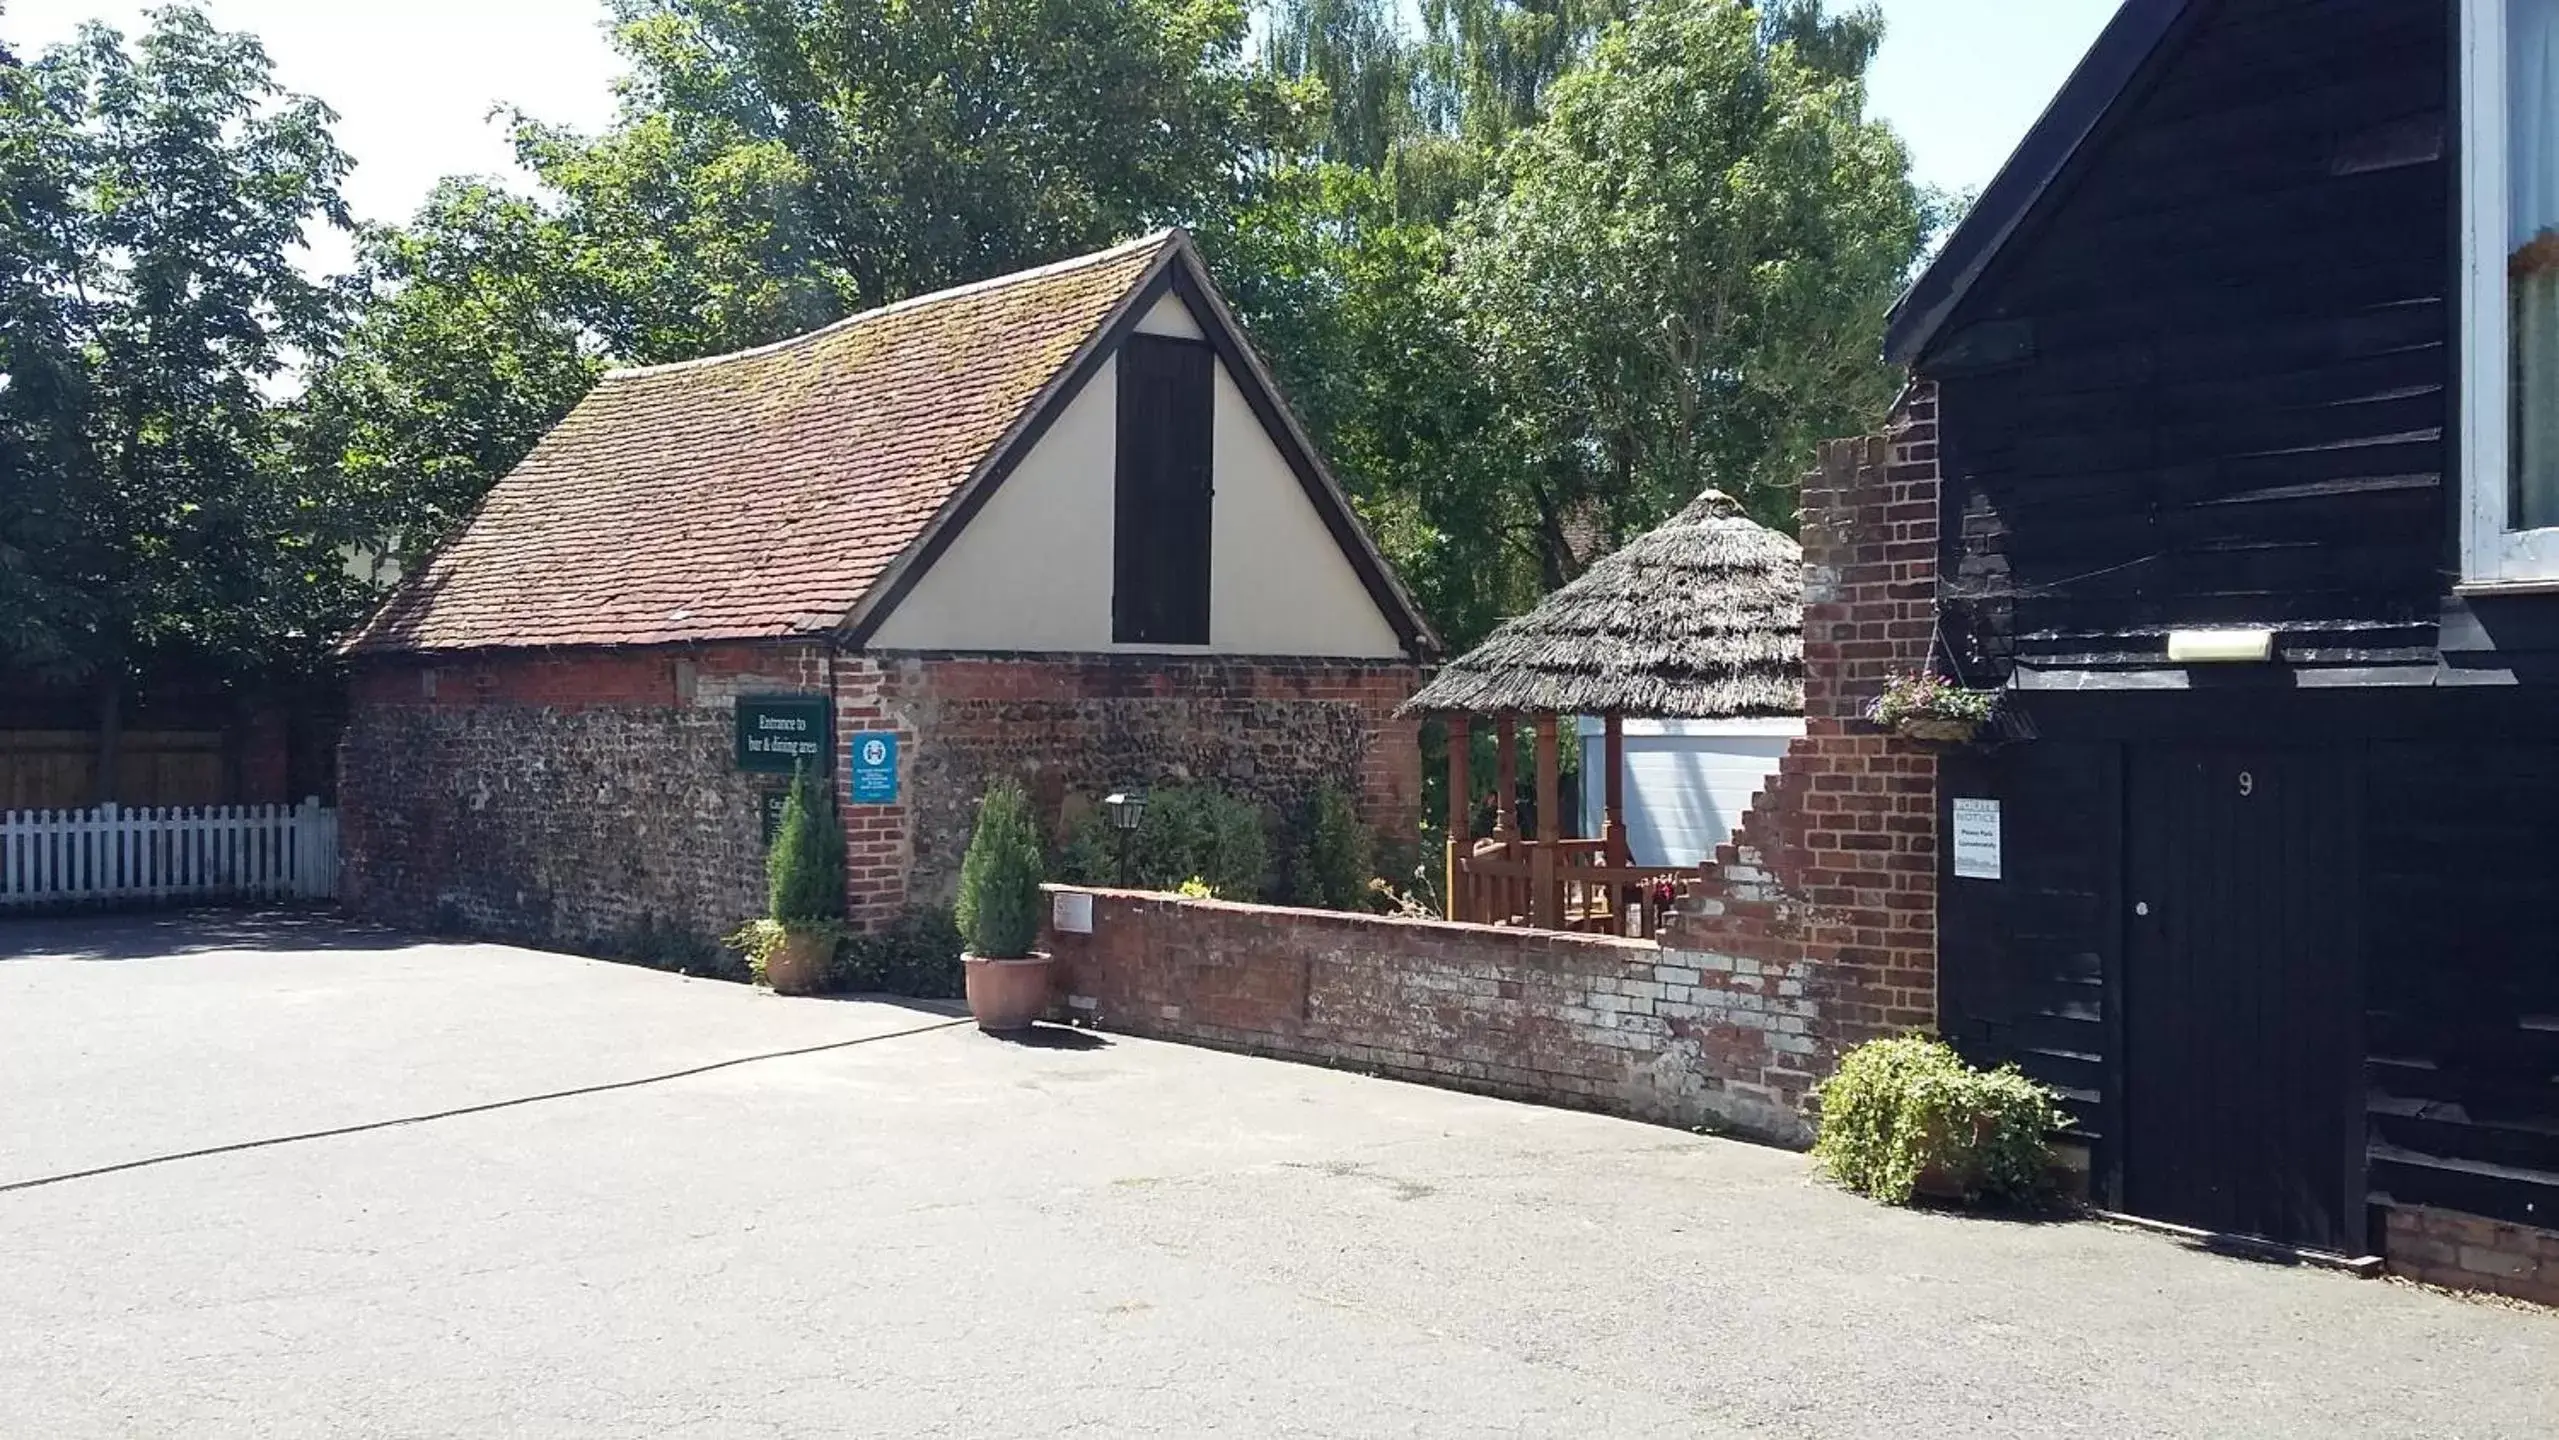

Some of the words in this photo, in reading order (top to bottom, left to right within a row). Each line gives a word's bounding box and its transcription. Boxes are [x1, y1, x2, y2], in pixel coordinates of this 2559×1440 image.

[759, 714, 796, 731] Entrance
[796, 717, 806, 731] to
[748, 734, 762, 752] bar
[763, 736, 770, 752] &
[771, 735, 798, 757] dining
[799, 741, 818, 754] area
[2239, 771, 2252, 797] 9
[1956, 811, 1998, 823] NOTICE
